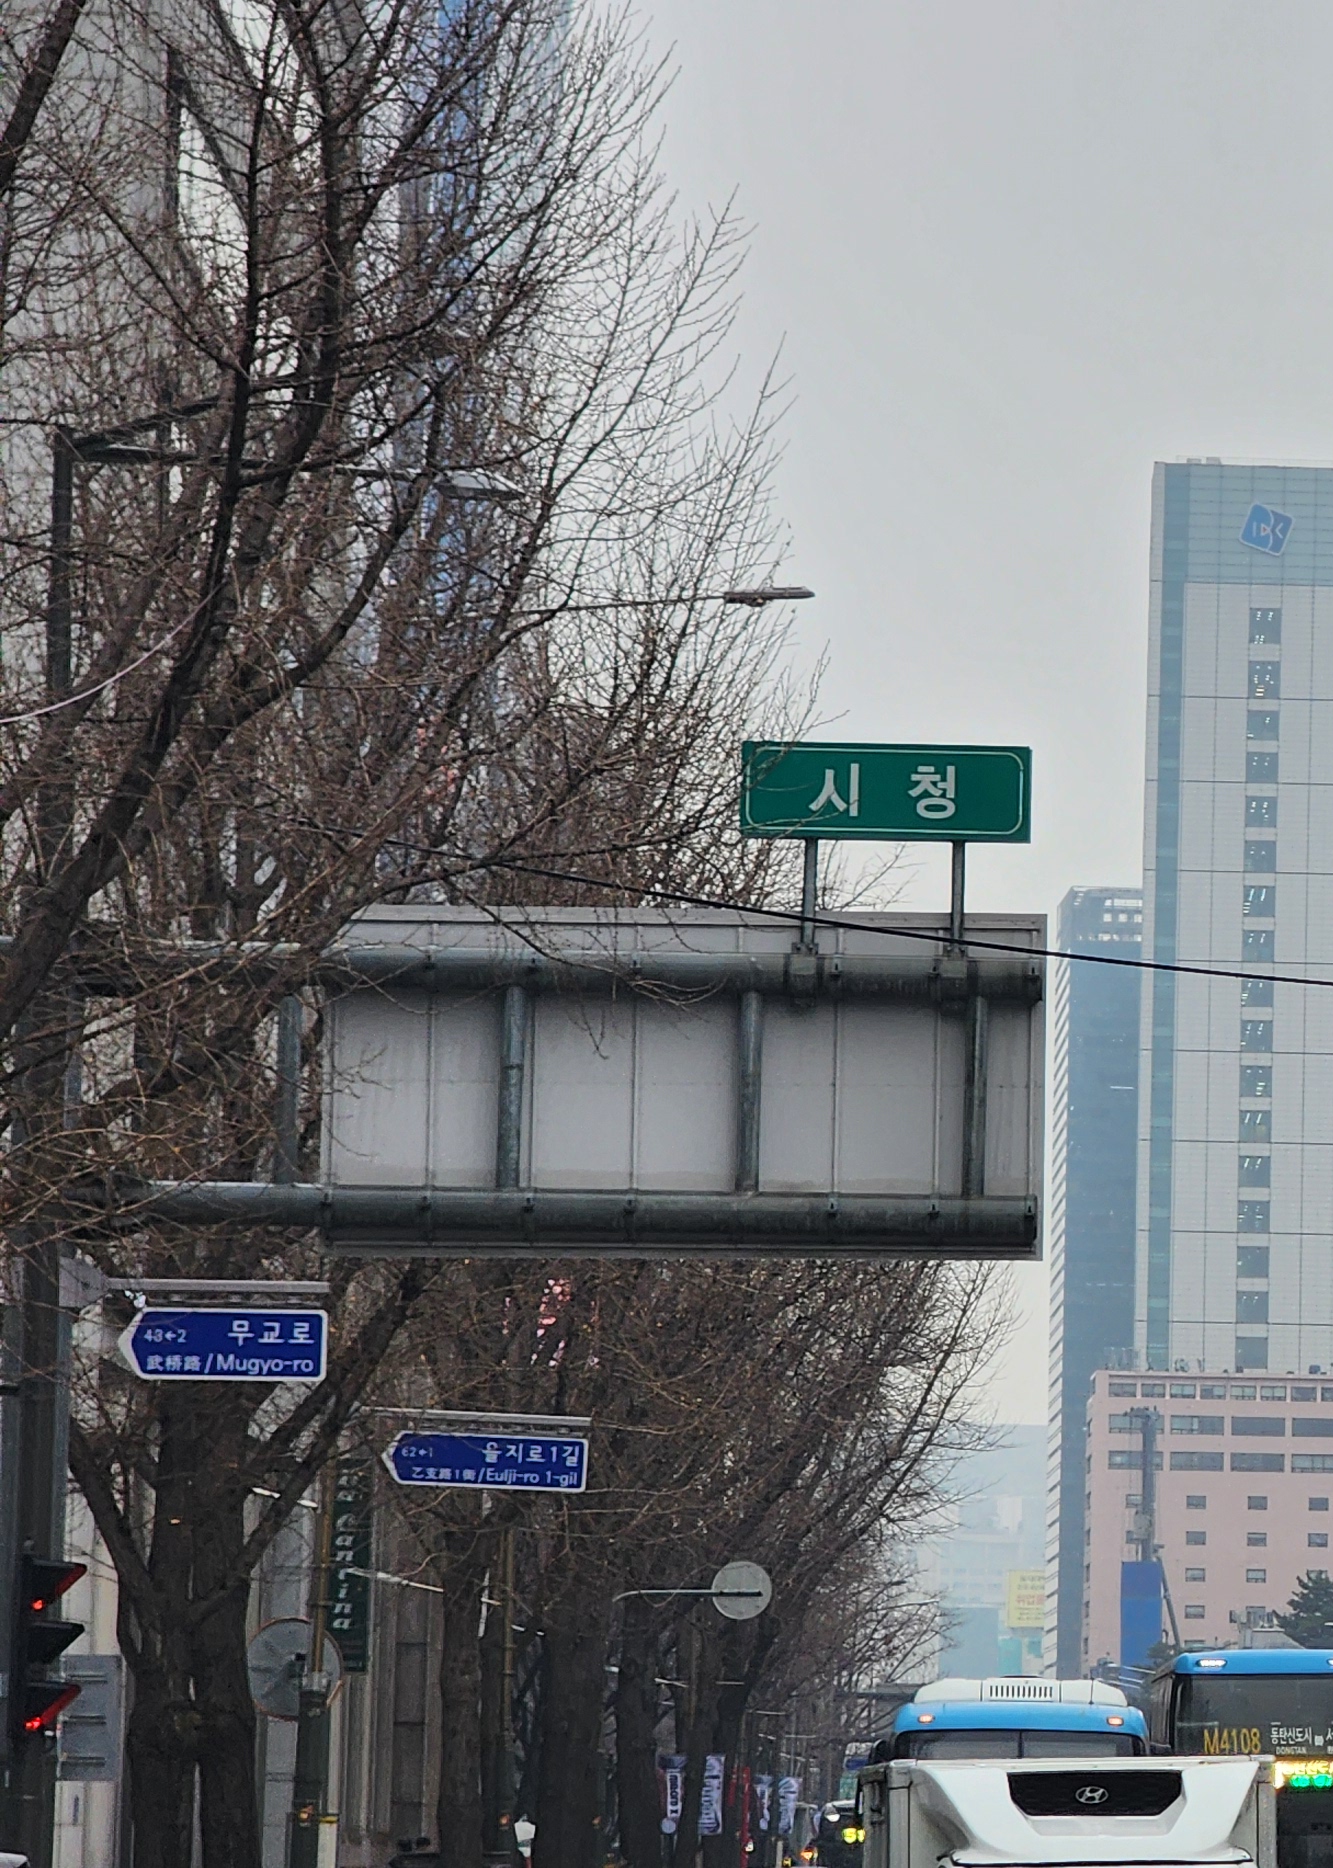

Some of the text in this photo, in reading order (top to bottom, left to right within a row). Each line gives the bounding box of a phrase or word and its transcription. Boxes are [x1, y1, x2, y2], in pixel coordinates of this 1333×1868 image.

[809, 763, 956, 819] 시청
[228, 1319, 315, 1346] 무교로
[481, 1442, 580, 1467] 을지로1길
[1203, 1728, 1262, 1755] M4108
[1270, 1727, 1312, 1745] 동탄신도시
